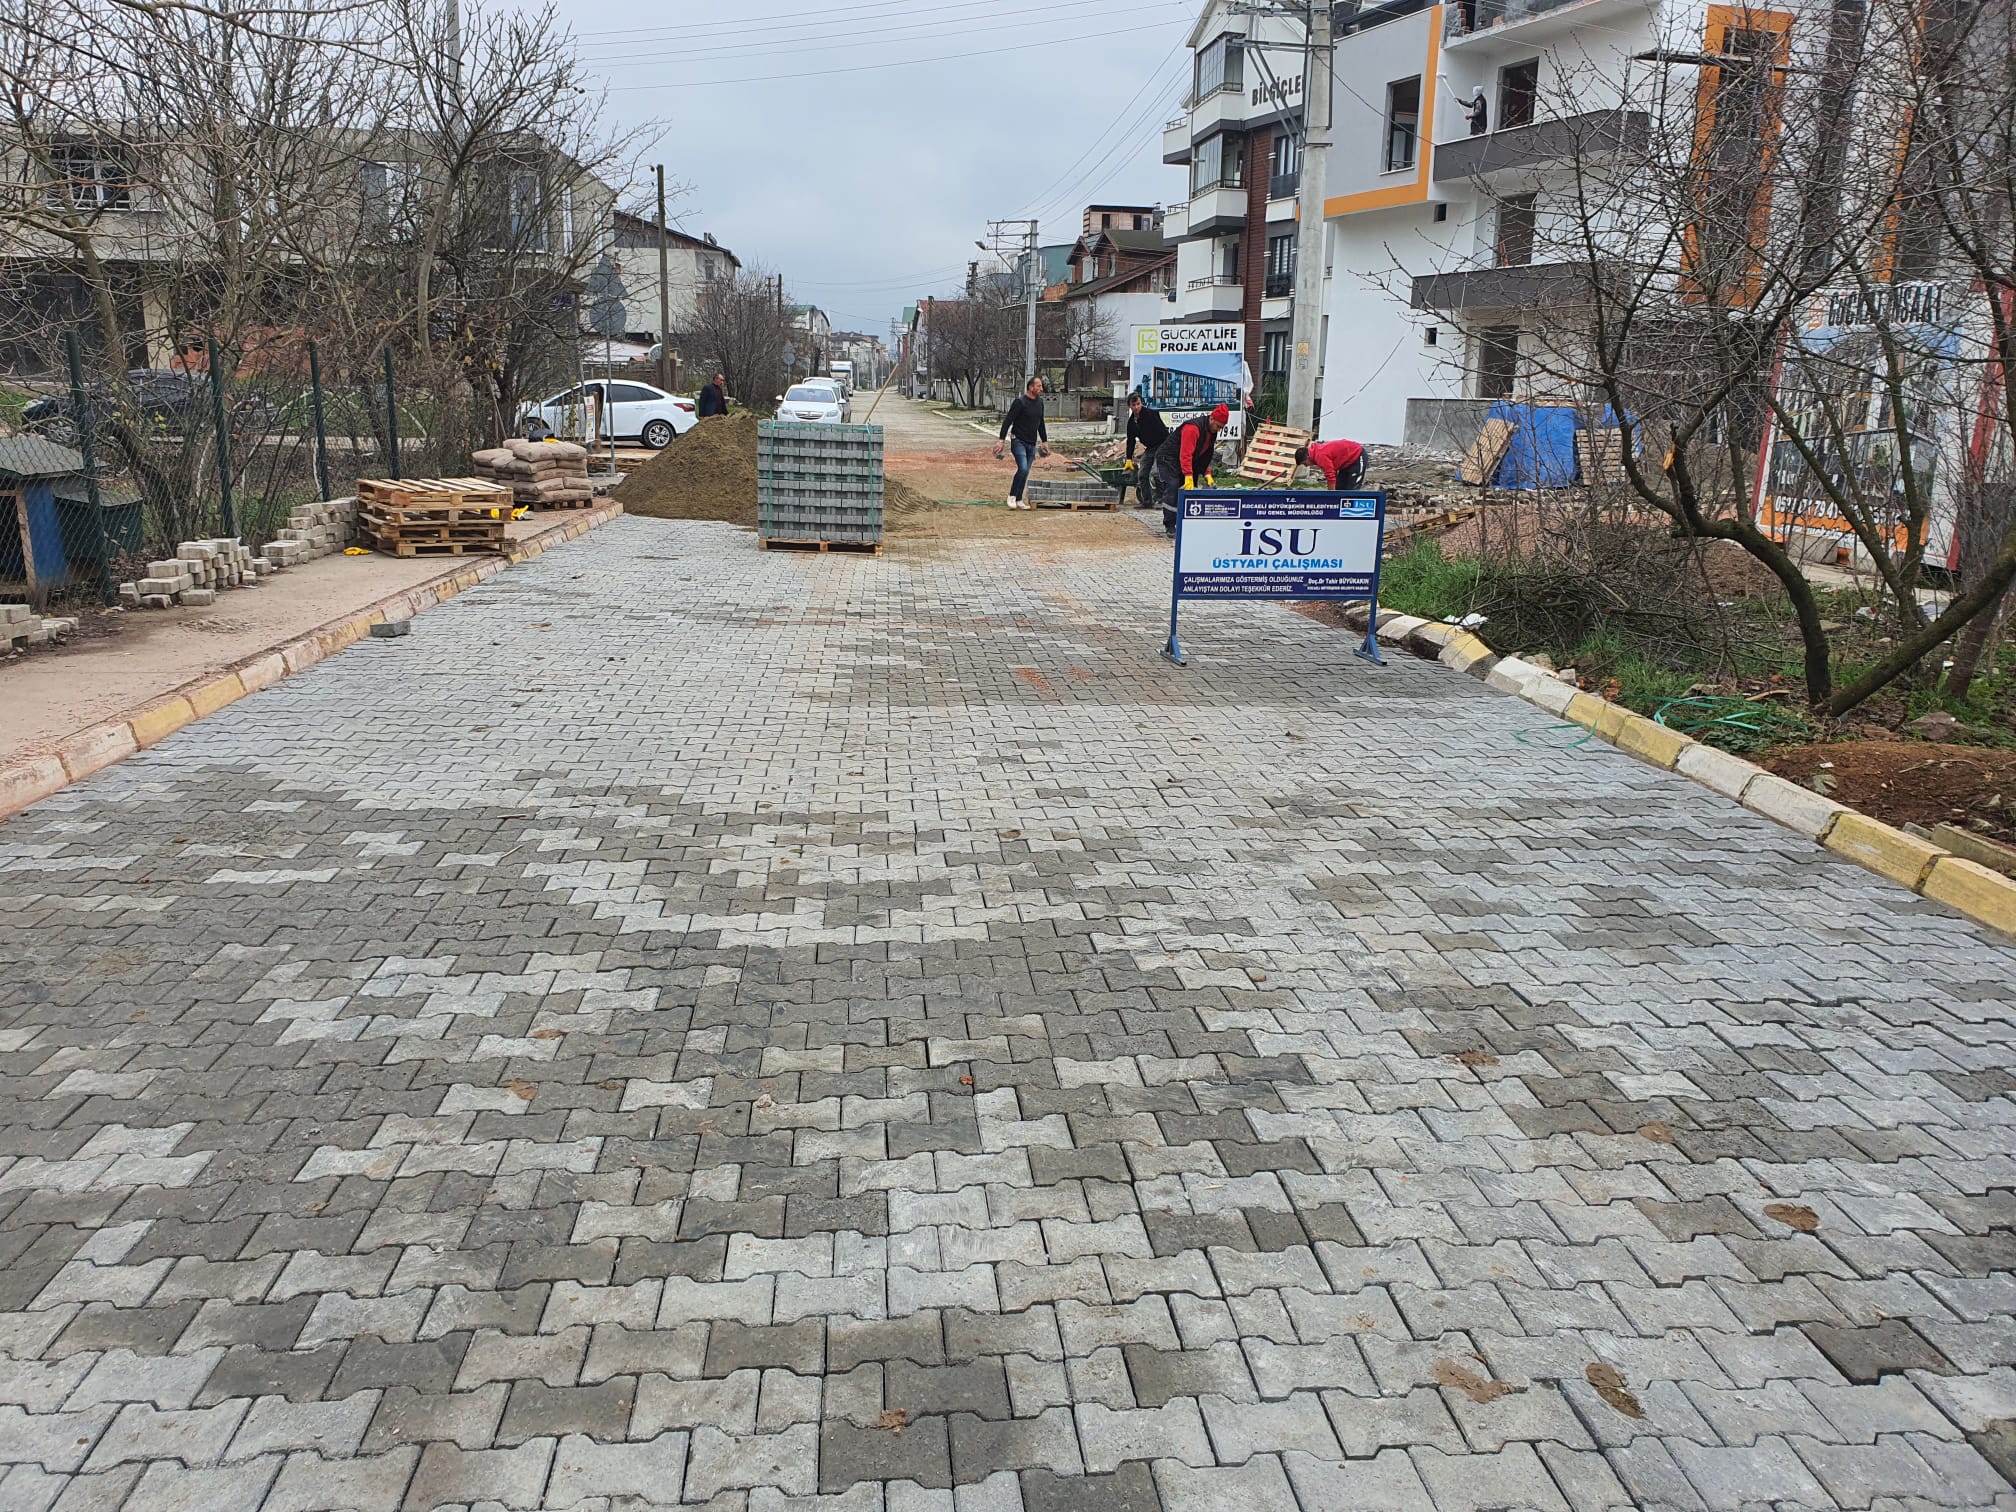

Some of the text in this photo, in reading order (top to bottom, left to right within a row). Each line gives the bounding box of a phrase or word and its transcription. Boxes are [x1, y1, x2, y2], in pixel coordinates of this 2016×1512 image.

[1160, 341, 1237, 352] PROJE ALANI
[1237, 521, 1322, 556] İSU
[1212, 557, 1343, 571] ÜSTYAPI ÇALIŞMASI
[1183, 575, 1304, 584] ÇALIŞMALARIMIZA GÖSTERMİŞ OLDUĞUNUZ
[1182, 586, 1219, 594] ANLAYIŞTAN
[1219, 585, 1240, 593] DOLAYI
[1241, 584, 1271, 594] TEŞEKKÜR
